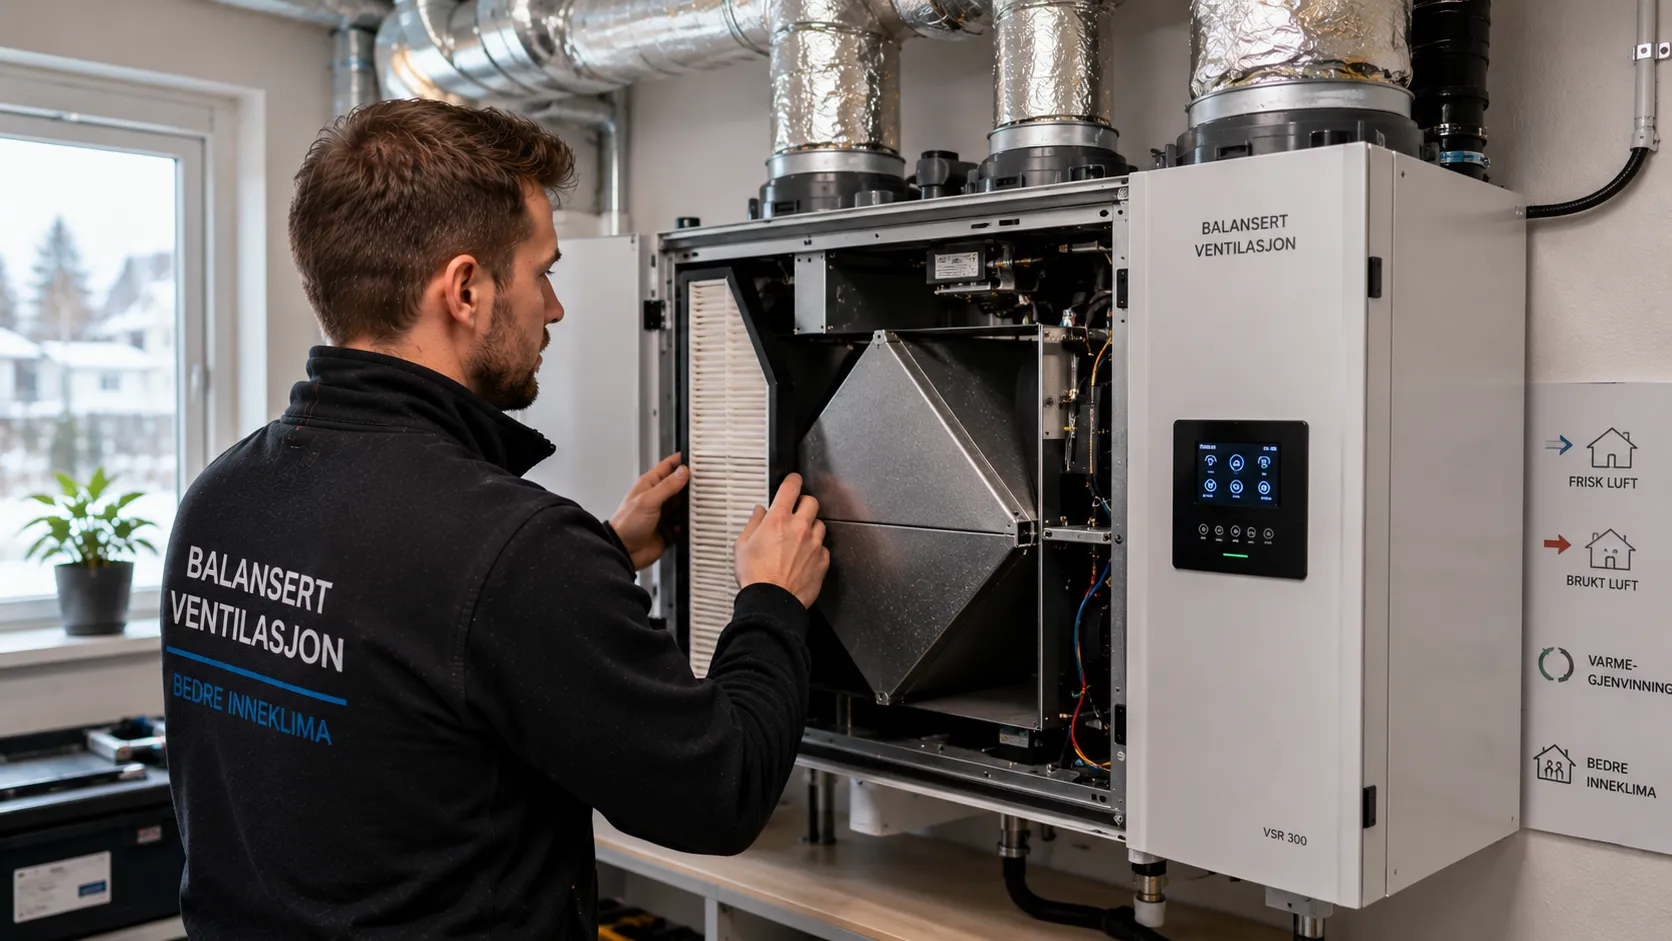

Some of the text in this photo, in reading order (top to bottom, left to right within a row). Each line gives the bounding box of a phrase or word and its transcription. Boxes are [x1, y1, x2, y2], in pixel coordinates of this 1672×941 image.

[1202, 214, 1288, 235] BALANSERT
[1195, 236, 1296, 257] VENTILASJON
[1569, 476, 1638, 489] FRISK LUFT
[186, 545, 333, 614] BALANSERT
[1566, 575, 1638, 591] BRUKT LUFT
[171, 590, 344, 673] VENTILASJON
[1588, 654, 1638, 671] VARME-
[1587, 674, 1672, 695] GJENVINNING
[173, 672, 332, 745] BEDRE INNEKLIMA
[1587, 757, 1628, 774] BEDRE
[1586, 776, 1657, 799] INNEKLIMA
[1263, 826, 1307, 846] VSR 300
